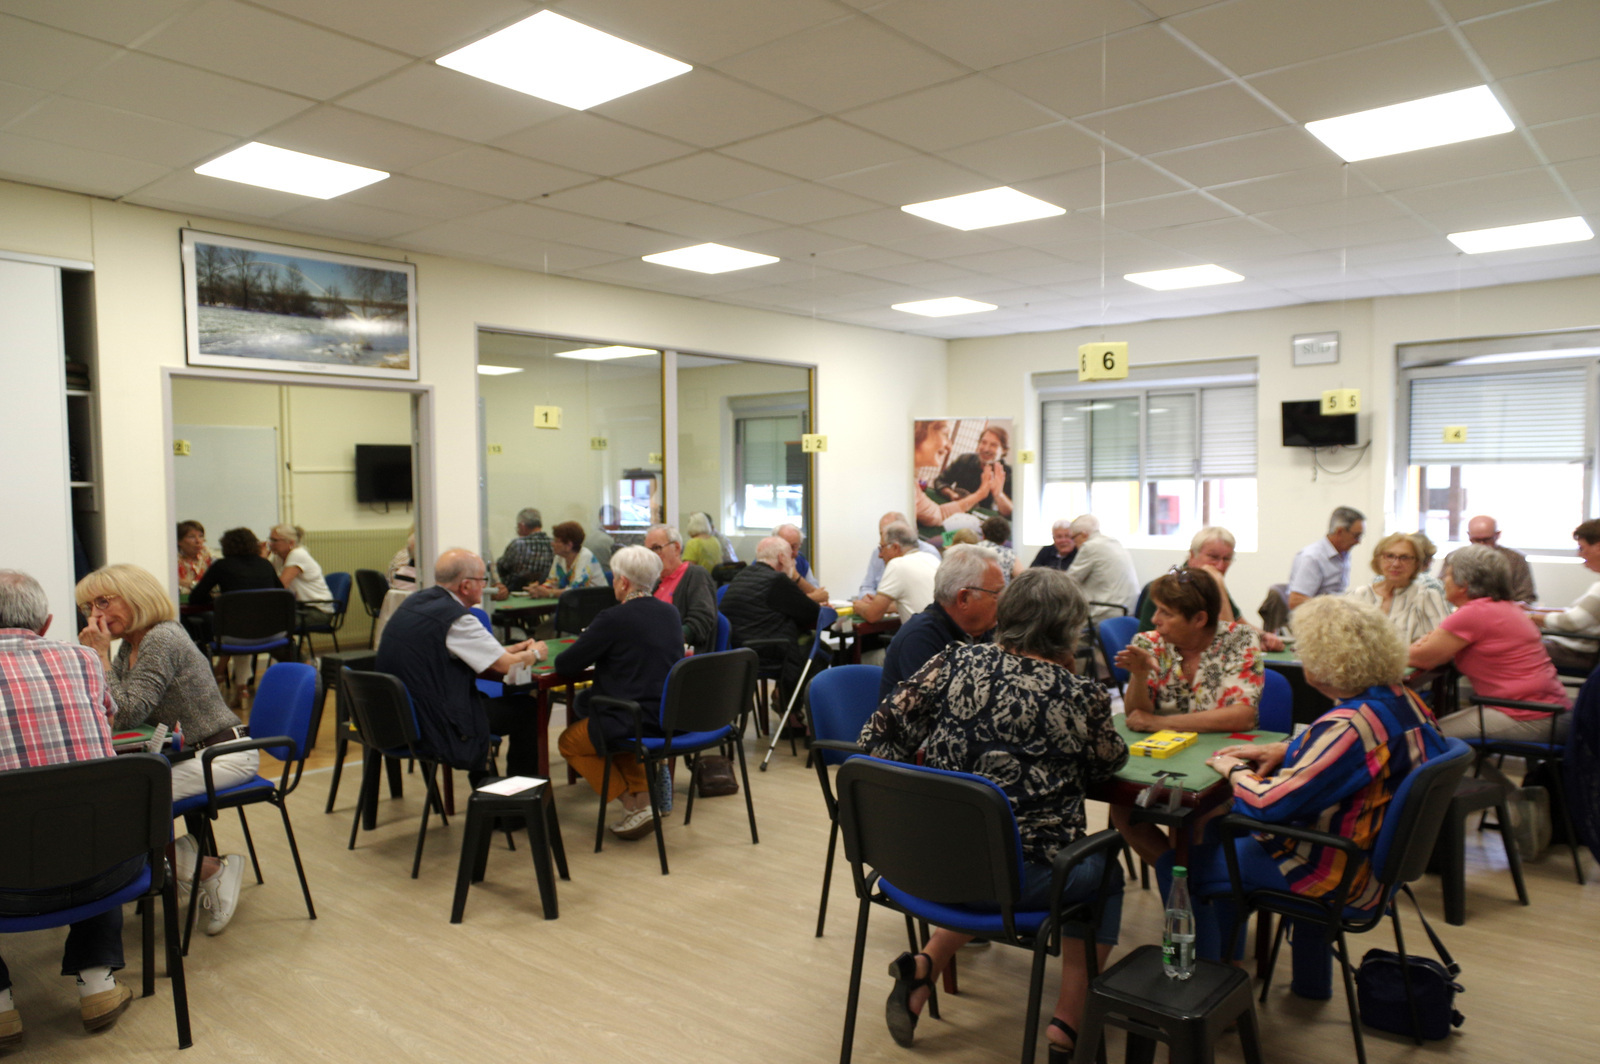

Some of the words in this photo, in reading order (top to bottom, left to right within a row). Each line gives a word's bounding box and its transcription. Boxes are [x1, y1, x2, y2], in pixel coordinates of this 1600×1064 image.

[1103, 351, 1115, 371] 6
[1329, 396, 1337, 408] 5
[1350, 395, 1357, 408] 5
[542, 411, 549, 423] 1
[1454, 430, 1461, 439] 4
[816, 439, 823, 449] 2
